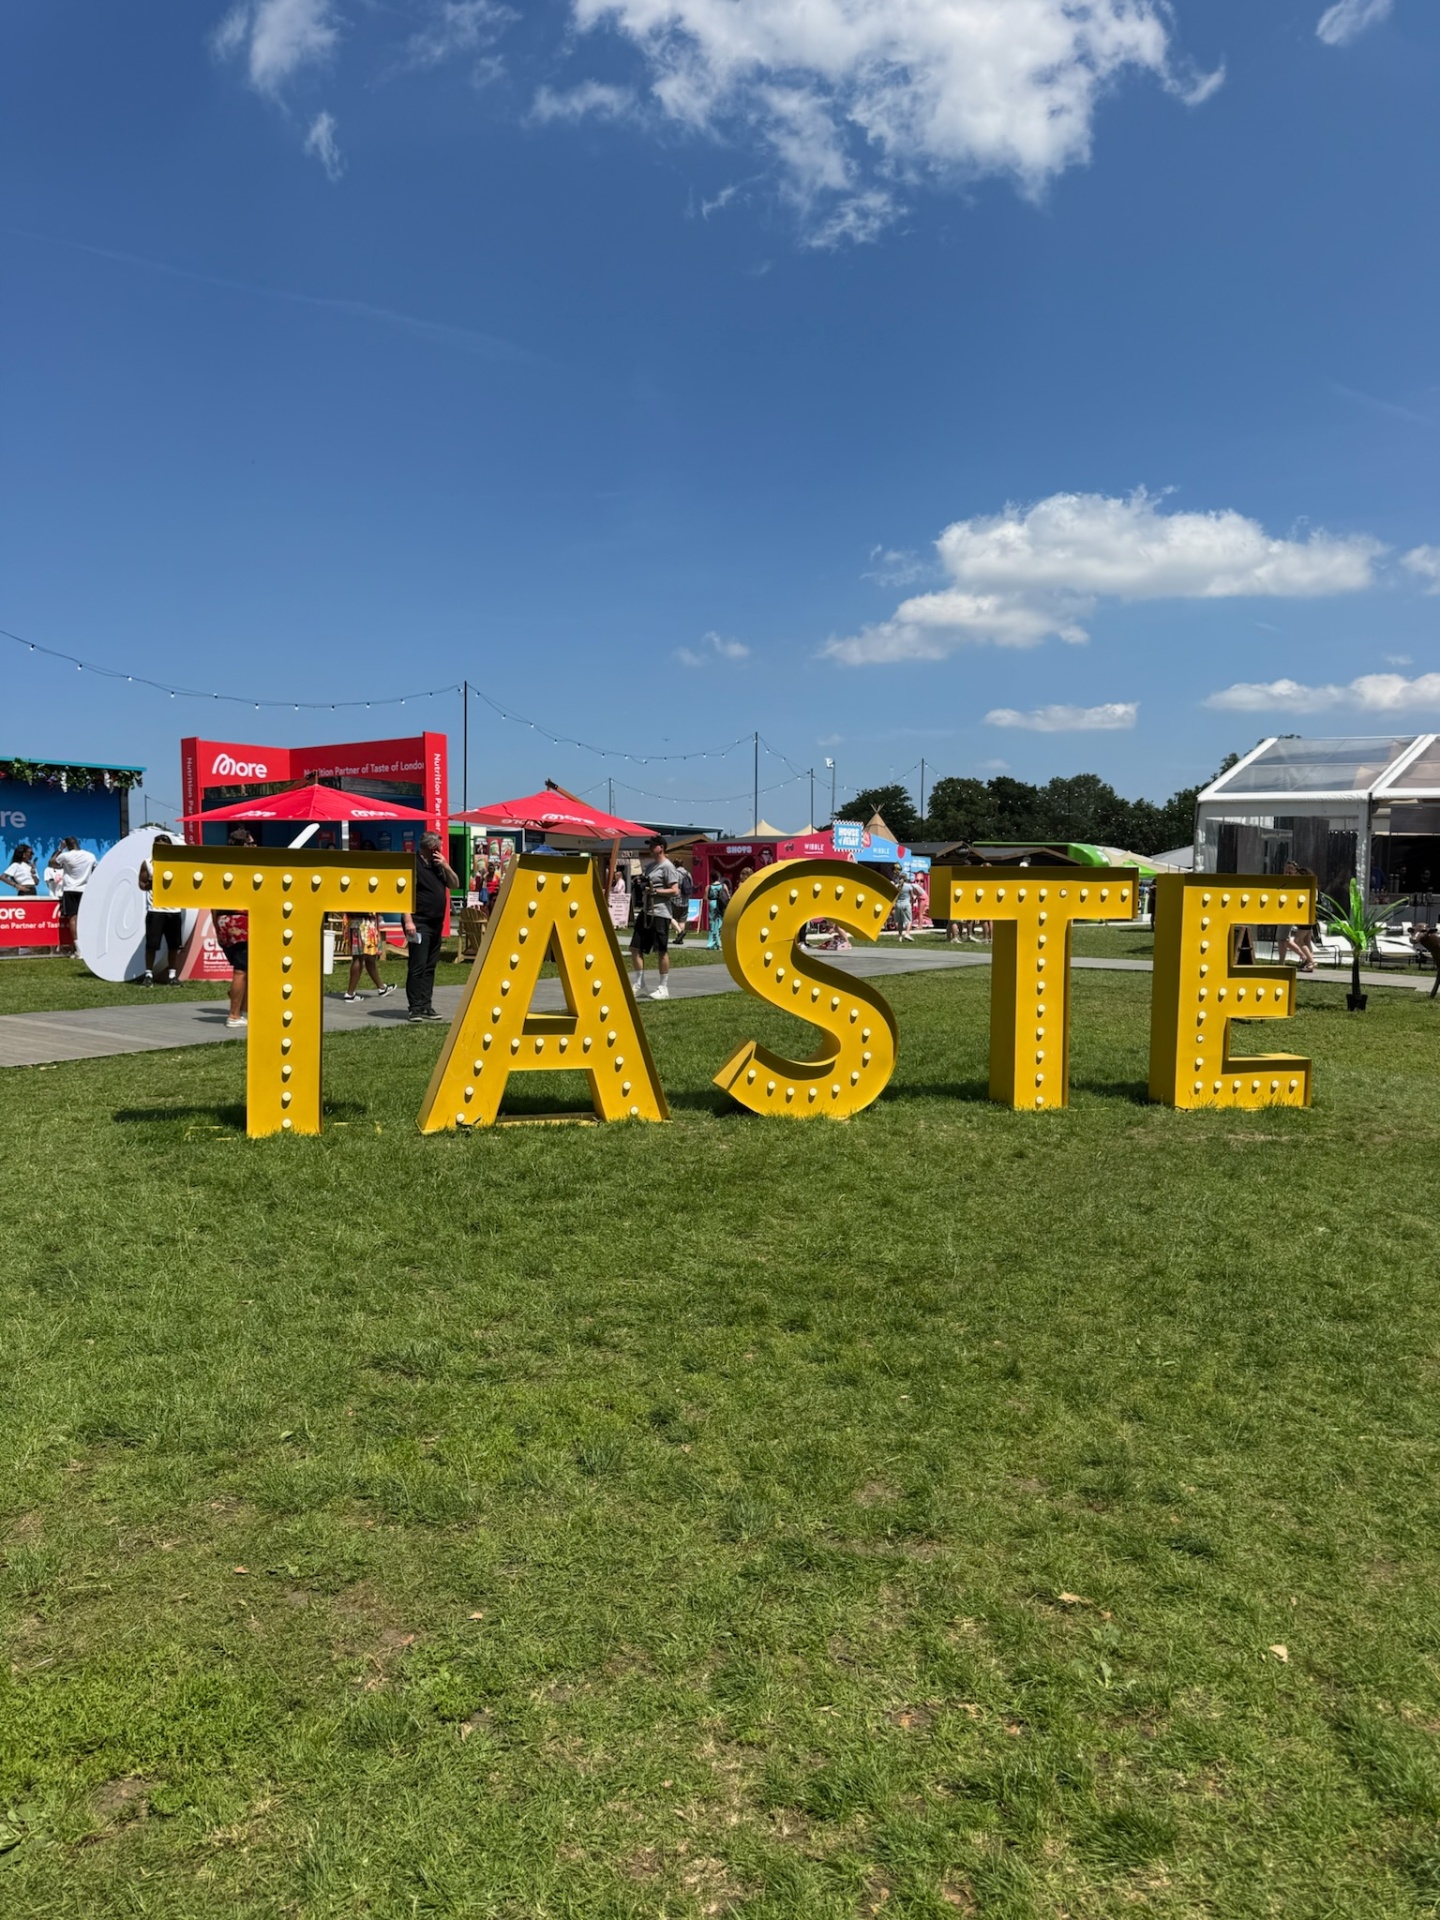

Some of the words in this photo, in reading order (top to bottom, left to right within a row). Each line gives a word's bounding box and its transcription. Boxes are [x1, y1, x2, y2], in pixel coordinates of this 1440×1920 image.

[186, 757, 194, 798] Nutrition
[335, 766, 360, 776] Partner
[361, 763, 370, 774] of
[371, 763, 390, 774] Taste
[391, 761, 399, 772] of
[434, 753, 442, 795] Nutrition
[435, 798, 443, 832] Parter
[726, 845, 753, 854] SHOTS
[804, 843, 824, 851] WIBBLE
[11, 921, 37, 930] Partner
[38, 920, 46, 929] of
[152, 844, 1316, 1139] TASTE
